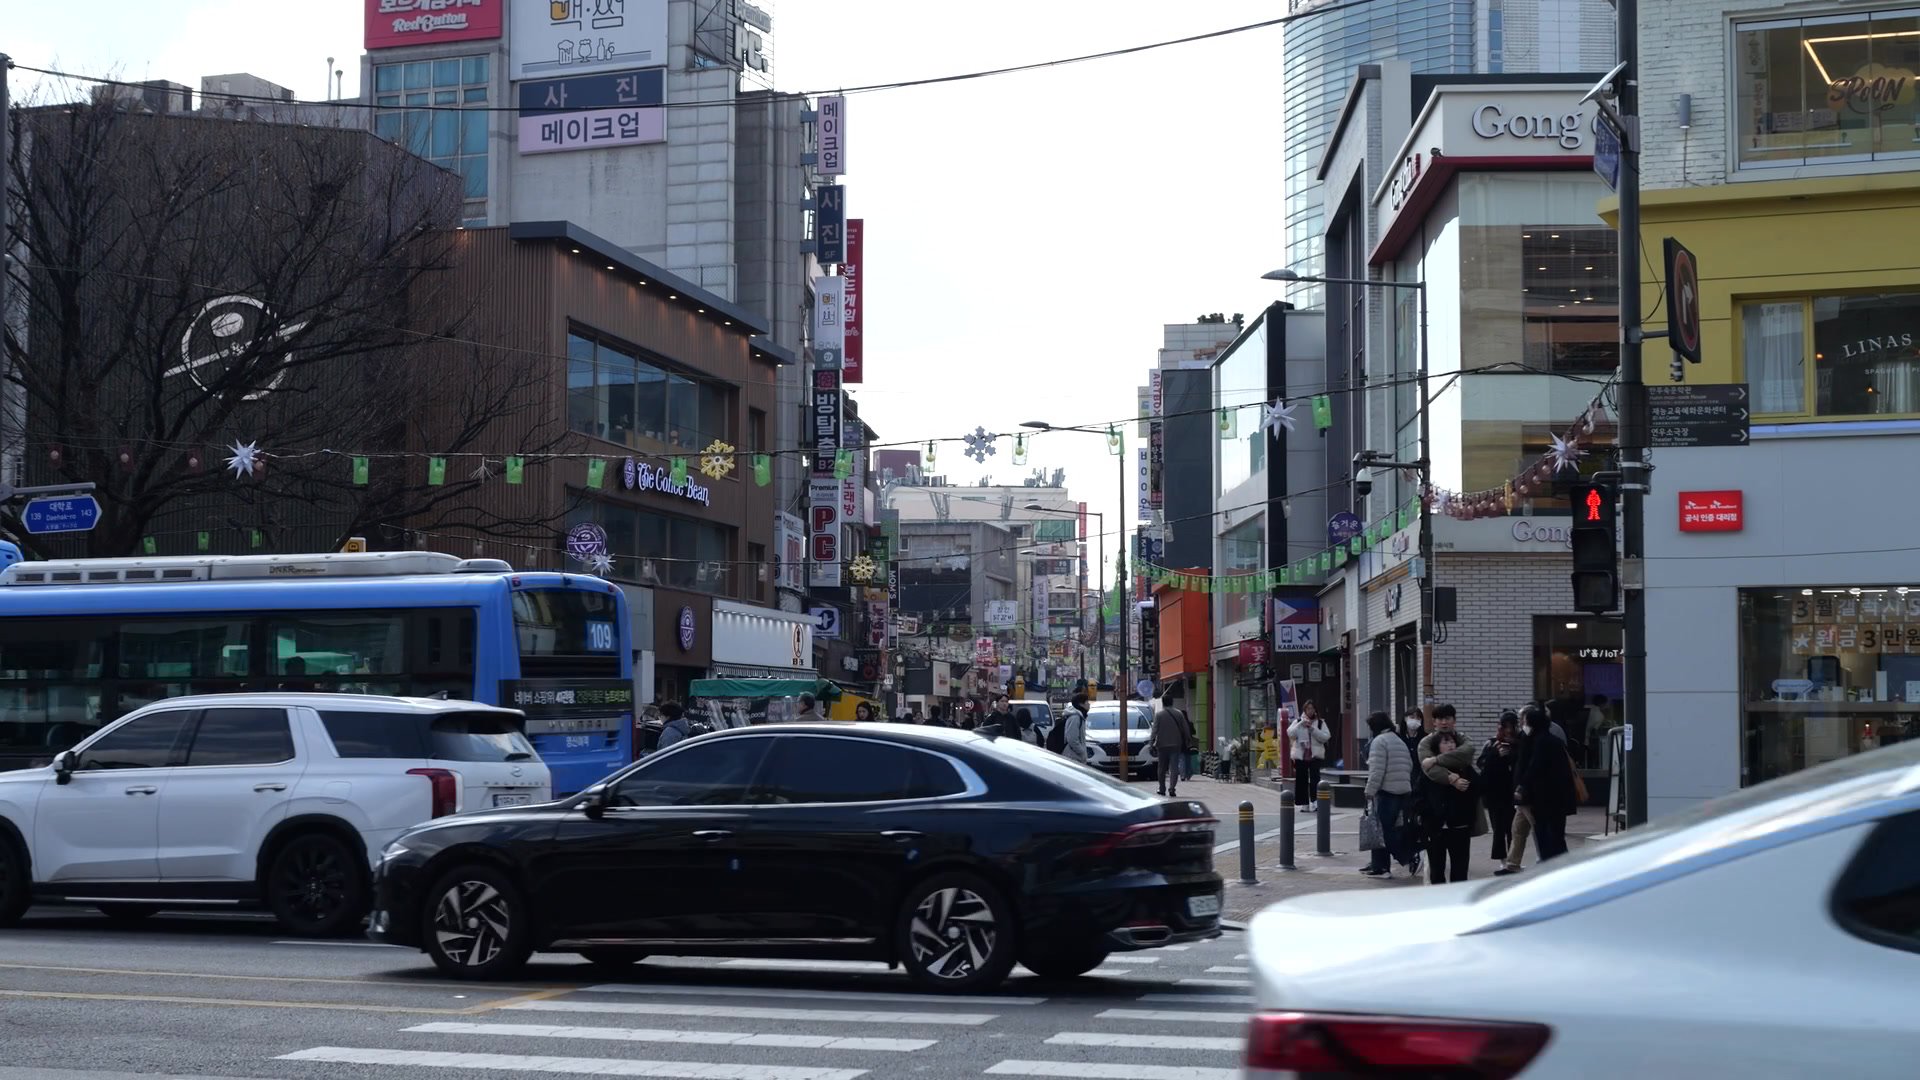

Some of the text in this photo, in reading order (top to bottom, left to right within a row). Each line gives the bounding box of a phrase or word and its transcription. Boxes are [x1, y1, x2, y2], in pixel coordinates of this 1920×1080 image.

[541, 111, 639, 145] 메이크업
[823, 101, 839, 169] 메이크업
[1472, 104, 1584, 150] Gong
[820, 190, 841, 245] 사진
[1842, 333, 1912, 358] LINAS
[1152, 373, 1161, 418] ARTBOX
[816, 393, 836, 458] 방탈출
[1651, 428, 1689, 437] 연우소극장
[638, 462, 654, 491] The
[685, 475, 710, 507] Bean
[811, 484, 839, 492] Premium
[844, 480, 856, 518] 노래방
[49, 501, 73, 512] 대학로
[80, 509, 92, 517] 143
[812, 505, 837, 561] PC
[889, 570, 897, 600] MOM'S
[591, 623, 612, 649] 109
[1251, 646, 1266, 661] 꽃
